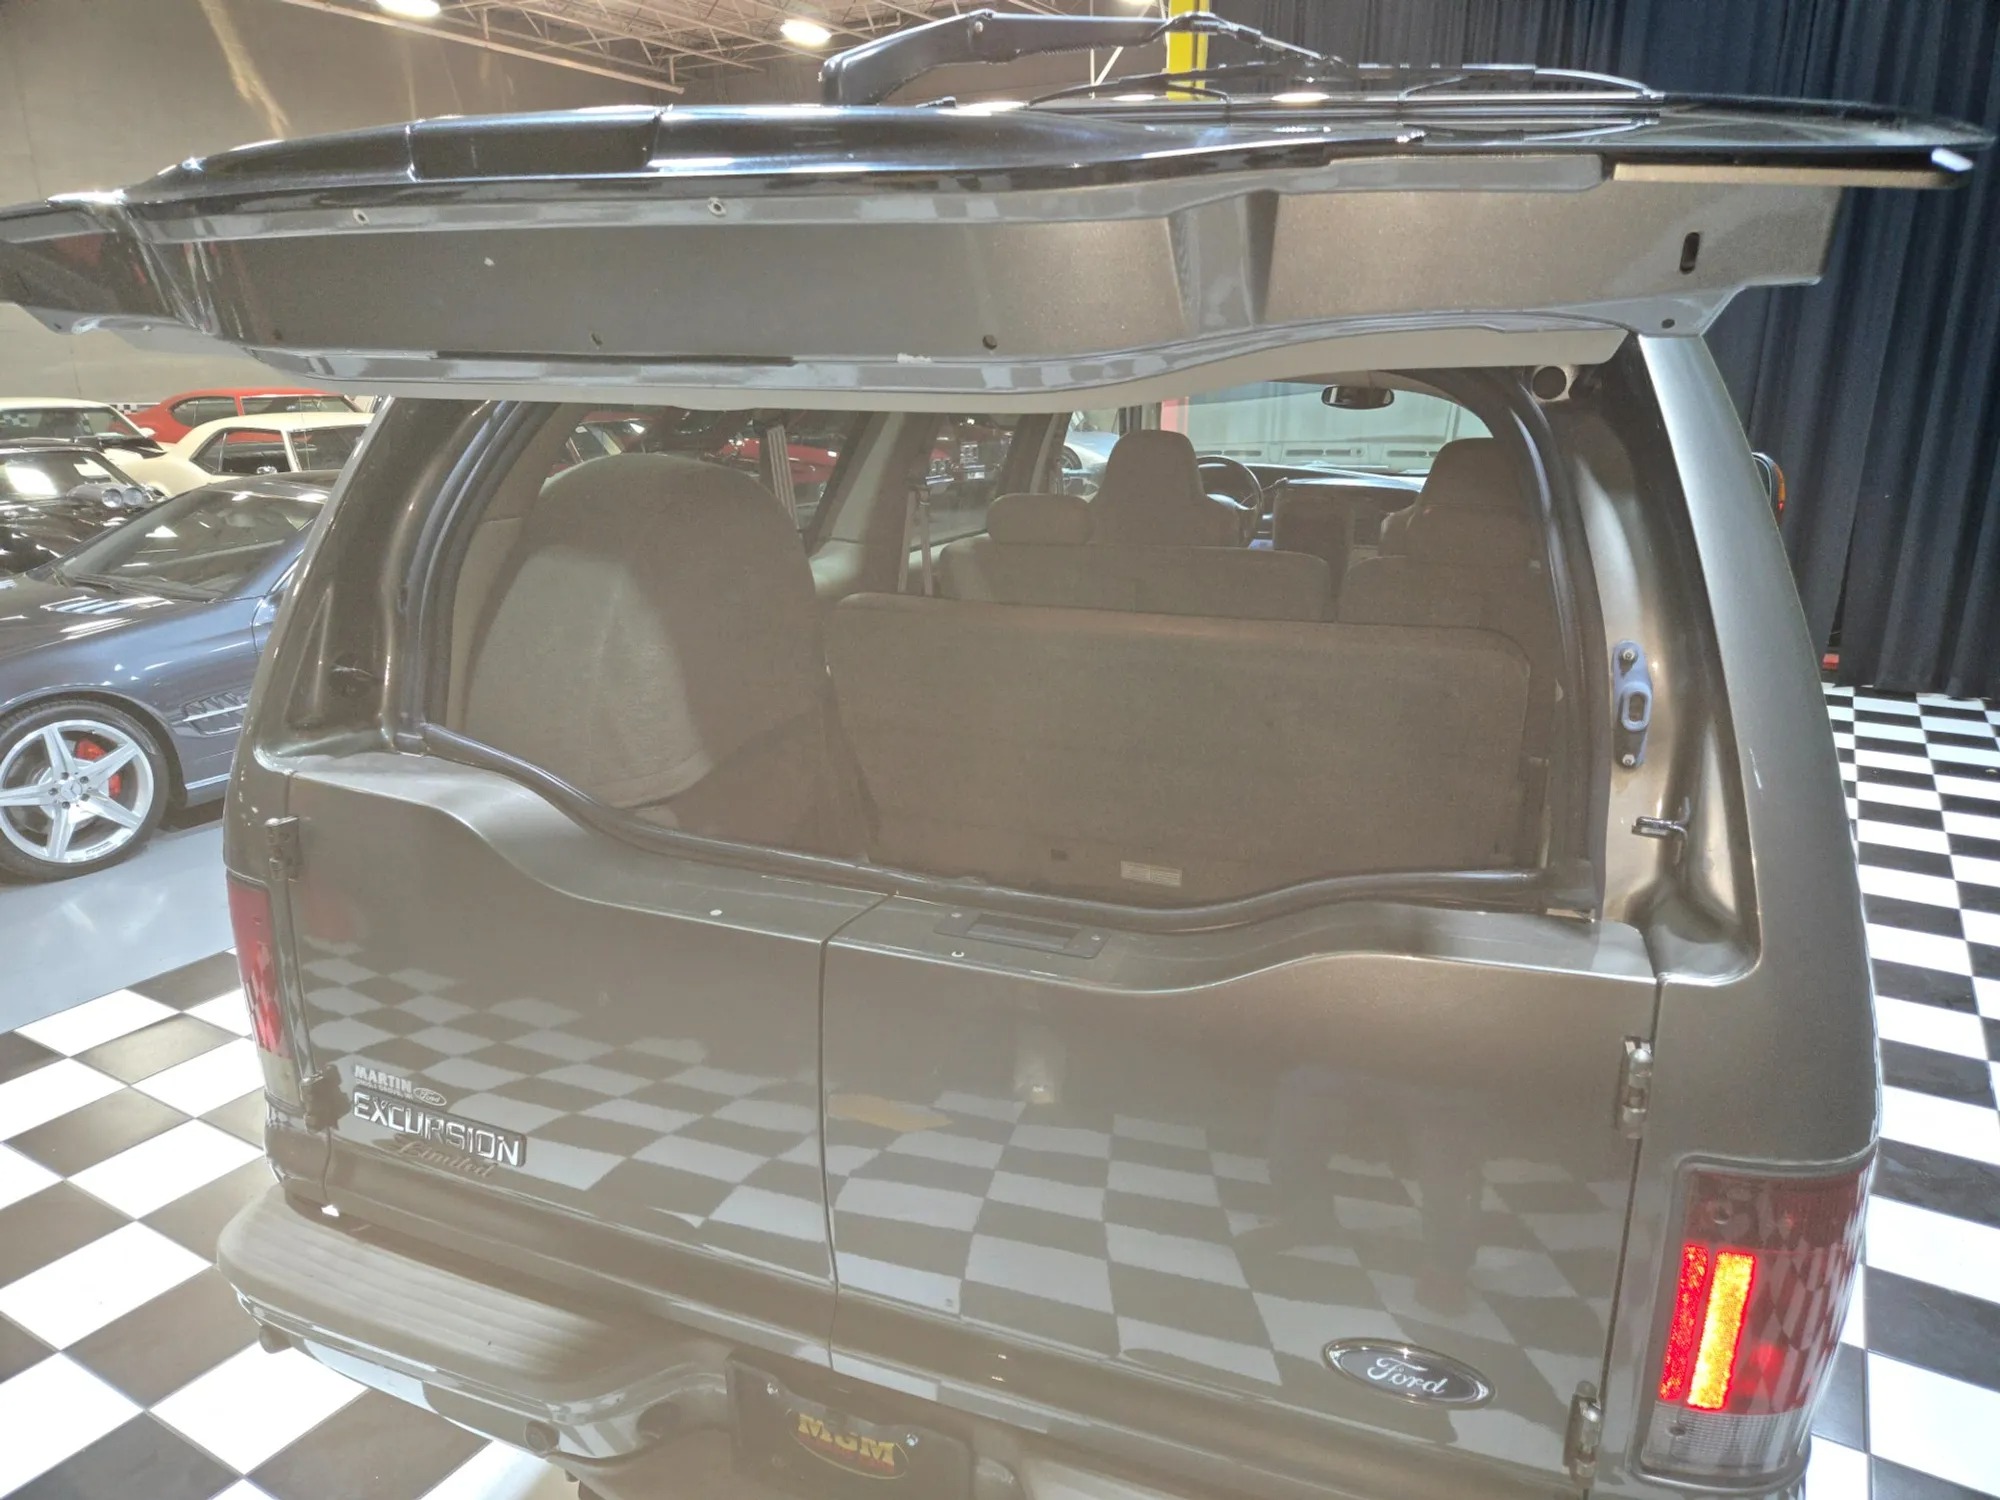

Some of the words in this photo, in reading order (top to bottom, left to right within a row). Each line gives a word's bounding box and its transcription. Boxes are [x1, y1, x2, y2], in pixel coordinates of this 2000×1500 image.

[354, 1064, 413, 1093] MARTIN
[353, 1091, 519, 1166] EXCURSION
[1367, 1356, 1449, 1394] Ford
[796, 1411, 896, 1467] MGM
